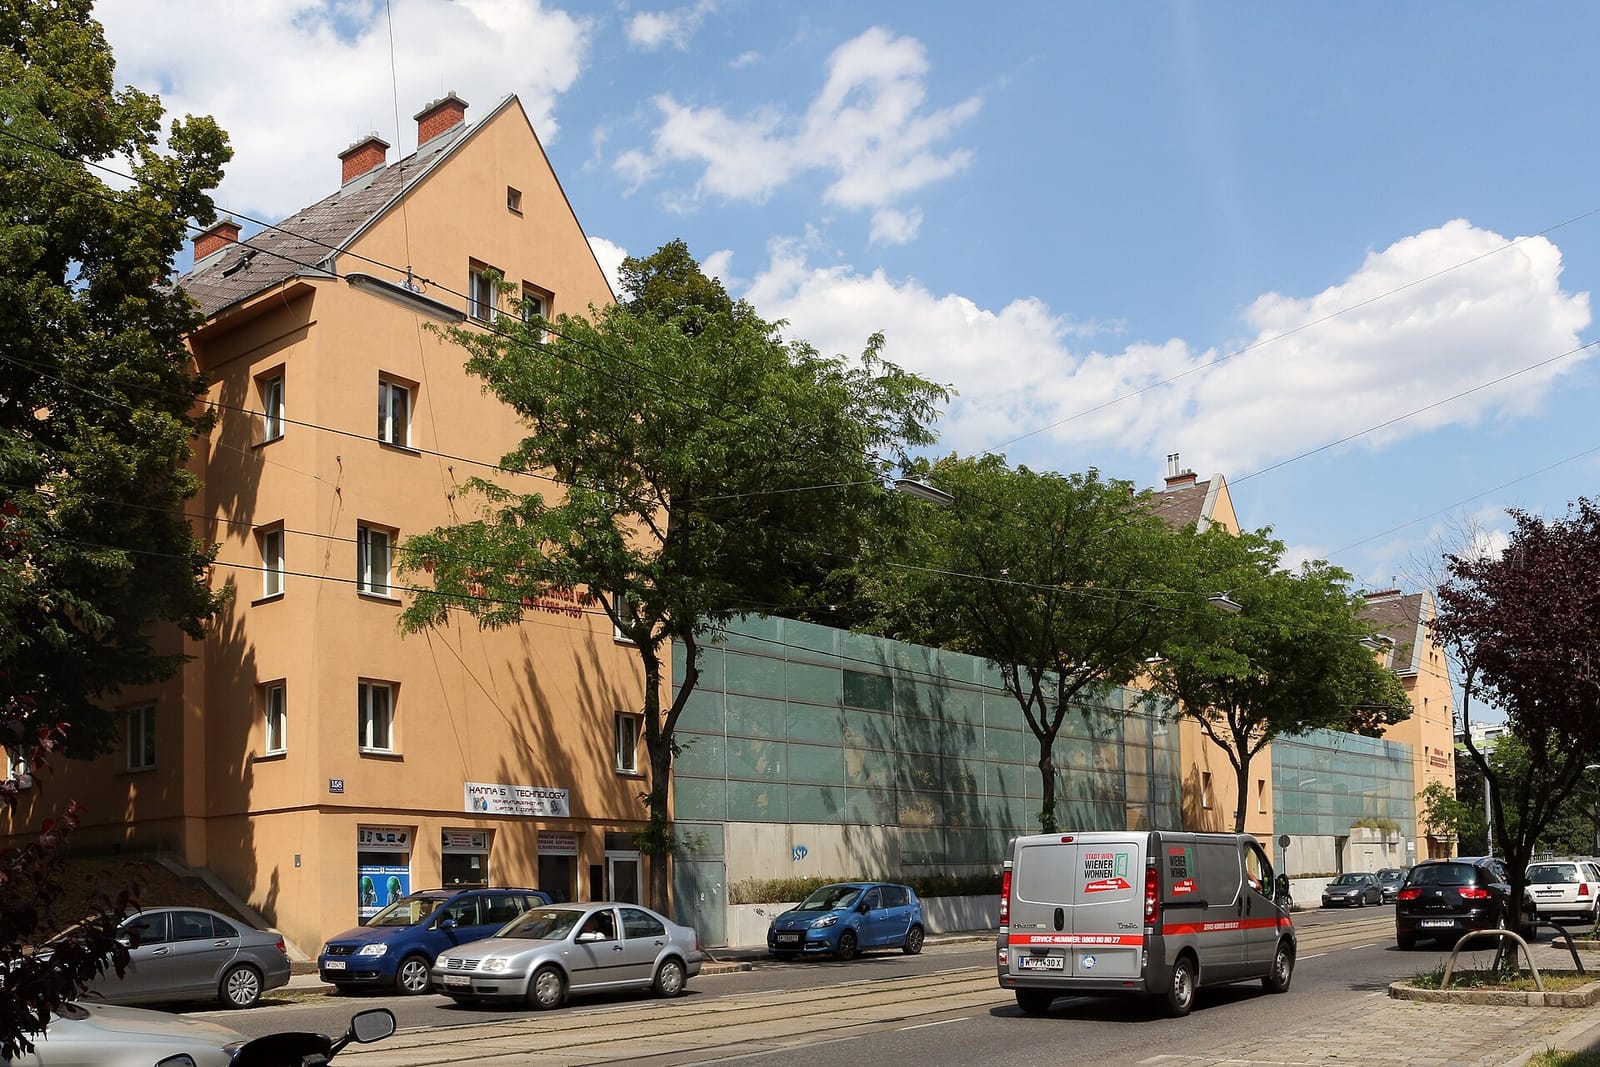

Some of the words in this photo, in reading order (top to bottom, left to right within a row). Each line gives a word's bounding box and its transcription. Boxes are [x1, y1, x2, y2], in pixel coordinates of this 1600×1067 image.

[331, 780, 343, 788] 158
[469, 786, 506, 796] HANNA'S
[515, 789, 566, 800] TECHNOLOGY
[1084, 860, 1114, 869] WIENER
[1084, 869, 1113, 879] WOHNEN
[1030, 935, 1081, 943] SERVICE-NUMMER:
